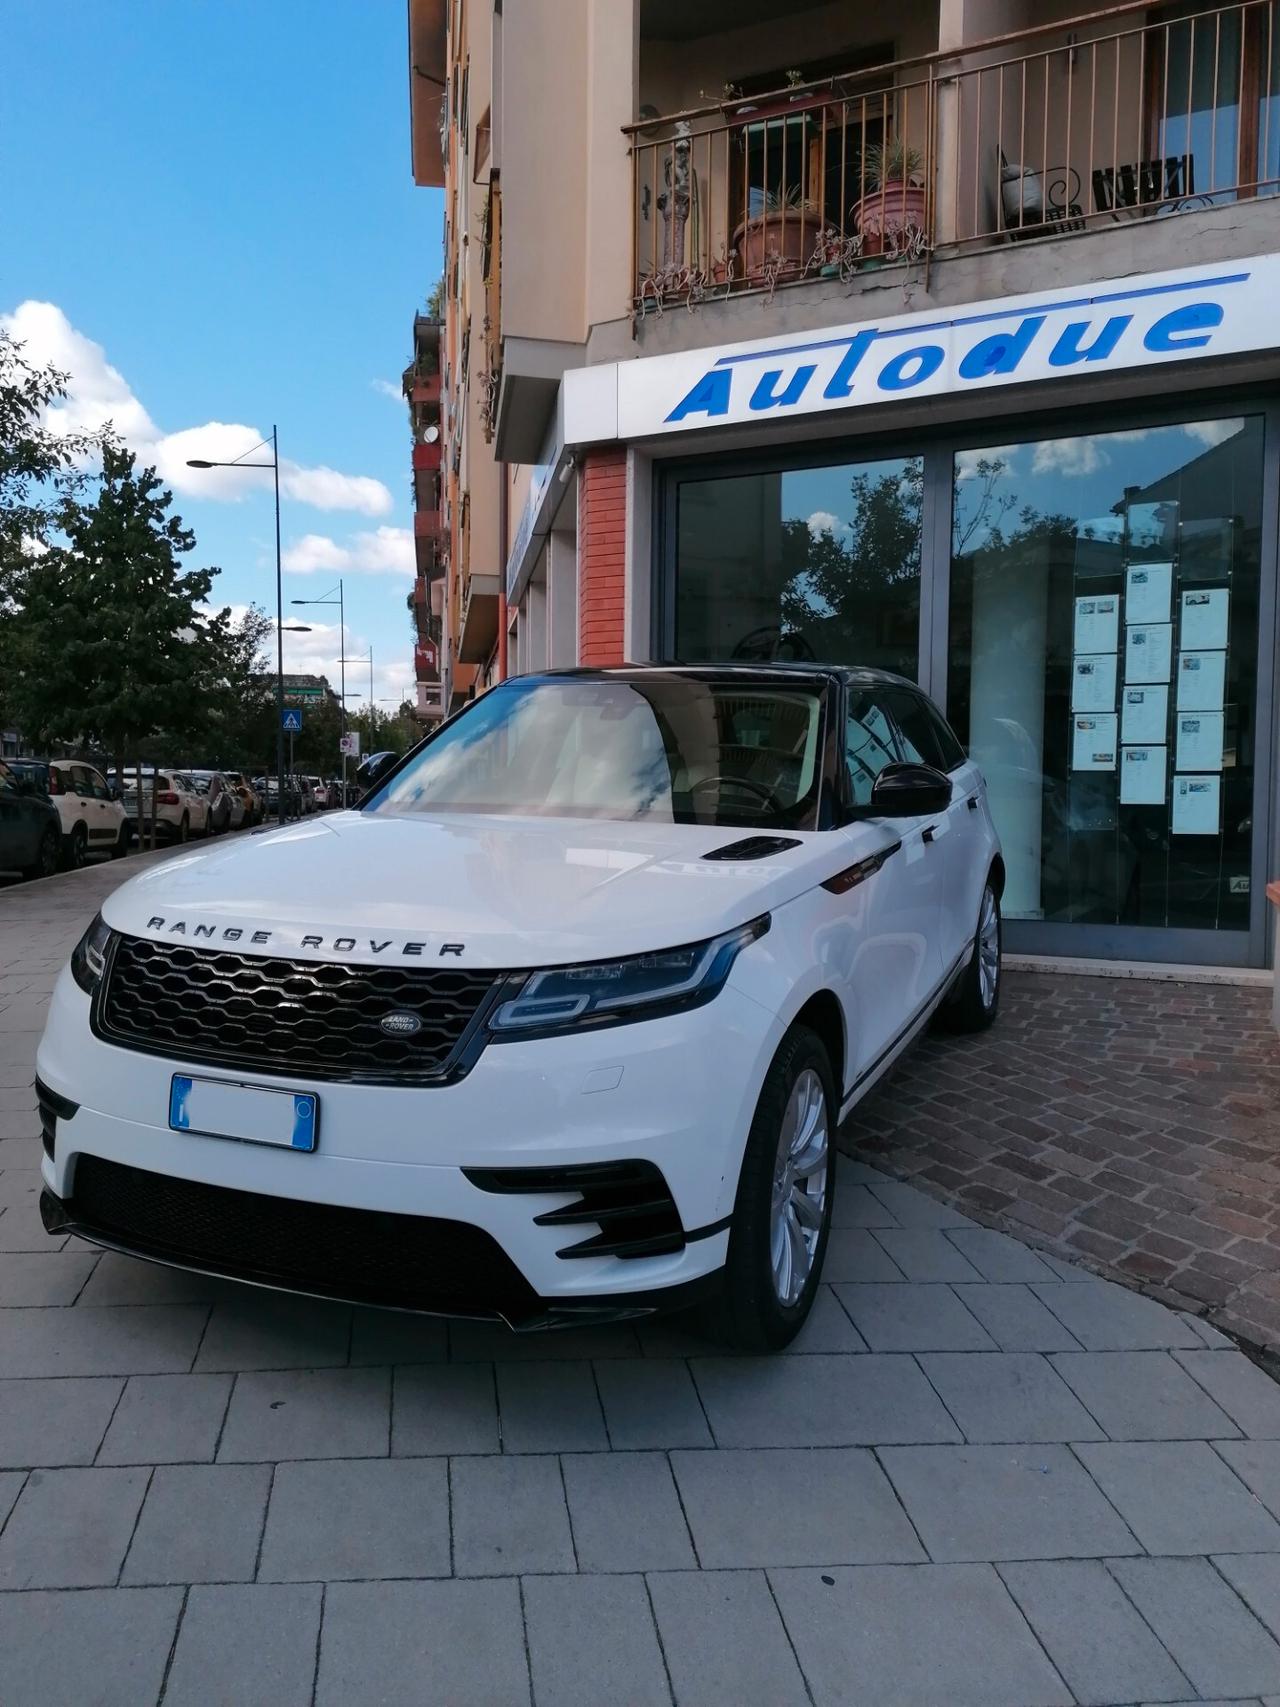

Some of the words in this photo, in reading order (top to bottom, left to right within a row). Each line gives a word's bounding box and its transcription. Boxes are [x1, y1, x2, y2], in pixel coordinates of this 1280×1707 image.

[662, 280, 1235, 423] Autodue
[147, 916, 272, 944] RANGE
[301, 935, 466, 957] ROVER
